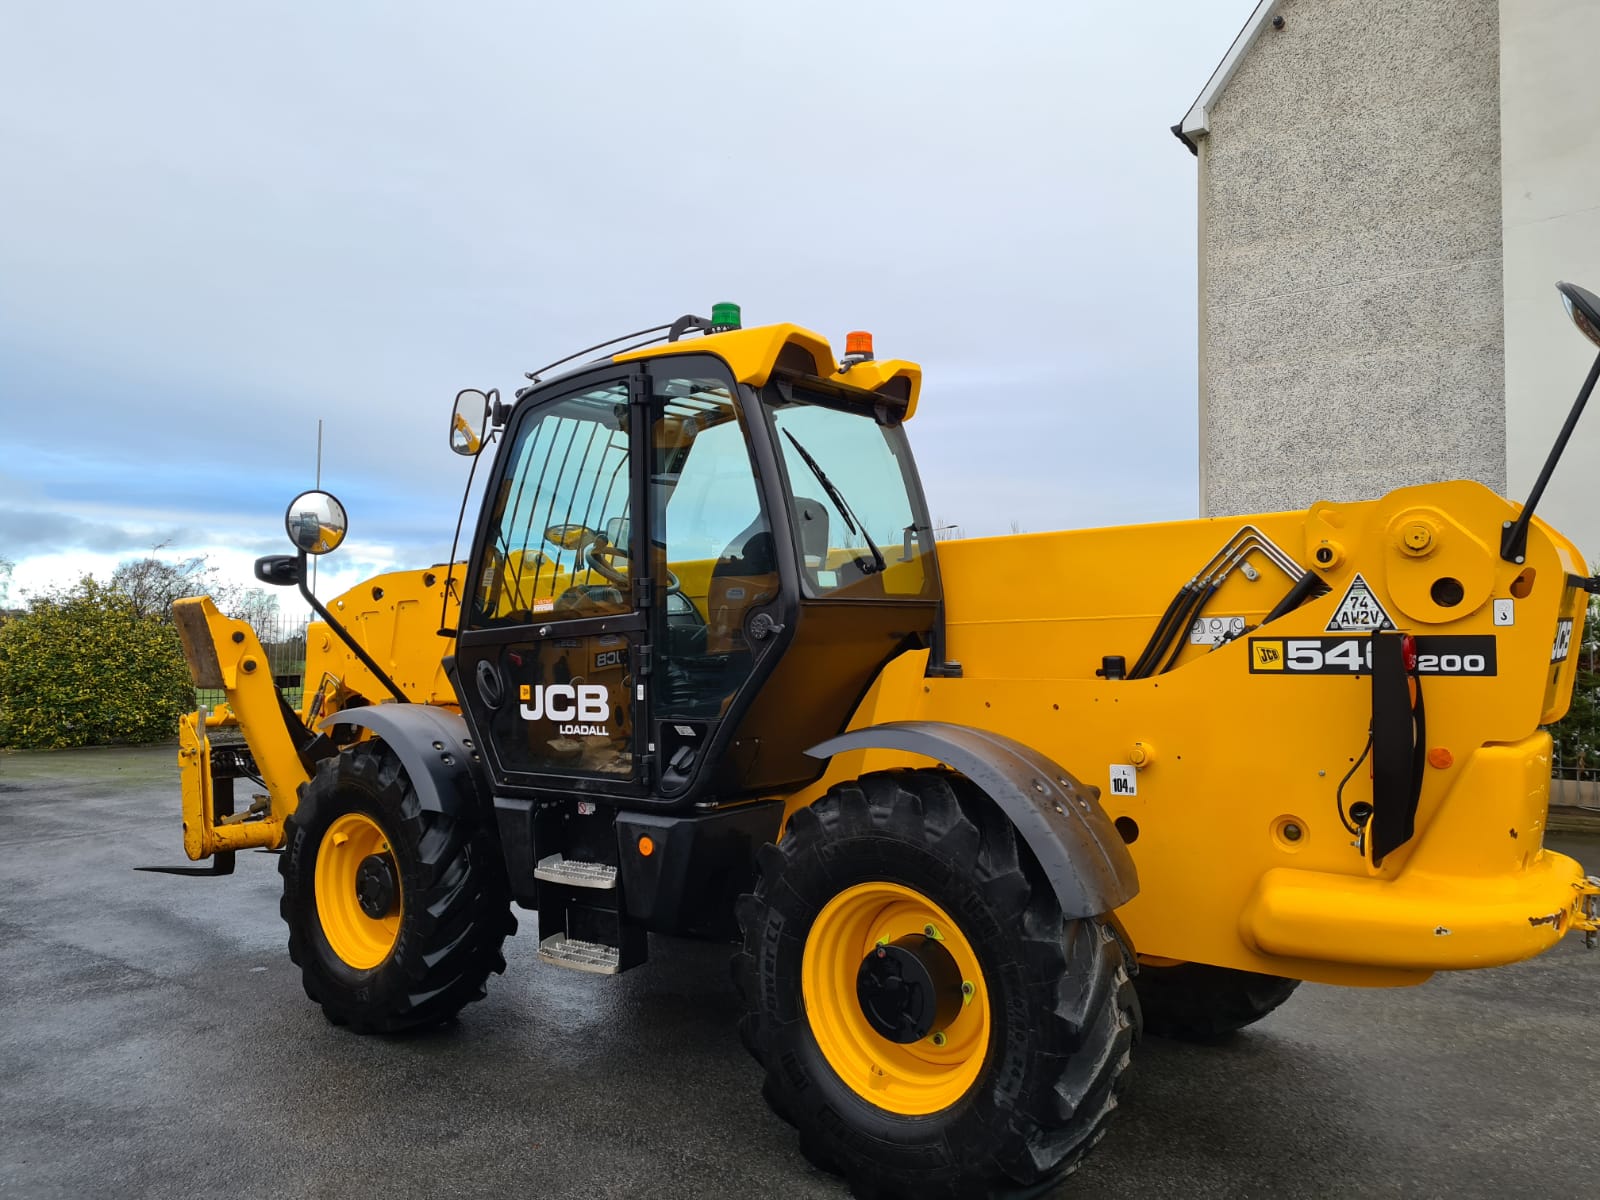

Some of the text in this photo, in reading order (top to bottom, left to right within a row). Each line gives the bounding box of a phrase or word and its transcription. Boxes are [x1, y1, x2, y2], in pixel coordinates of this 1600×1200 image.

[1350, 596, 1369, 610] 74
[1341, 610, 1380, 625] AW2V
[1261, 648, 1279, 662] JCB
[520, 684, 610, 721] JCB
[560, 725, 609, 736] LOADALL
[1112, 778, 1128, 793] 104
